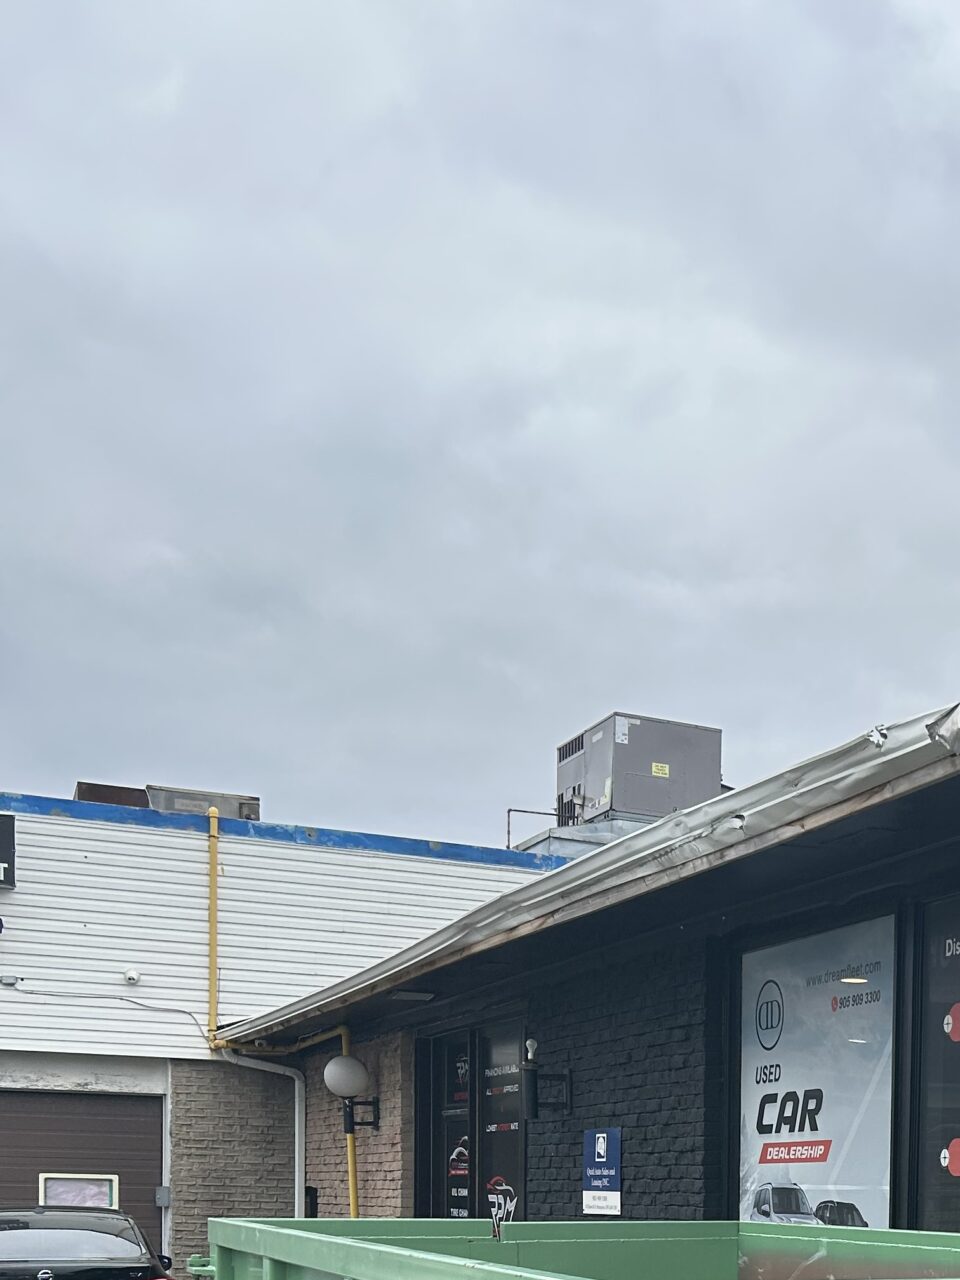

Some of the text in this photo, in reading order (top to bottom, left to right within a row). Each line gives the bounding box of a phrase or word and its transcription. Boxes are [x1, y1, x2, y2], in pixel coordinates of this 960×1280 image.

[806, 961, 881, 987] www.dreamfleet.com
[839, 989, 881, 1009] 905 909 3300
[755, 1064, 781, 1084] USED
[756, 1088, 824, 1135] CAR
[767, 1145, 825, 1160] DEALERSHIP
